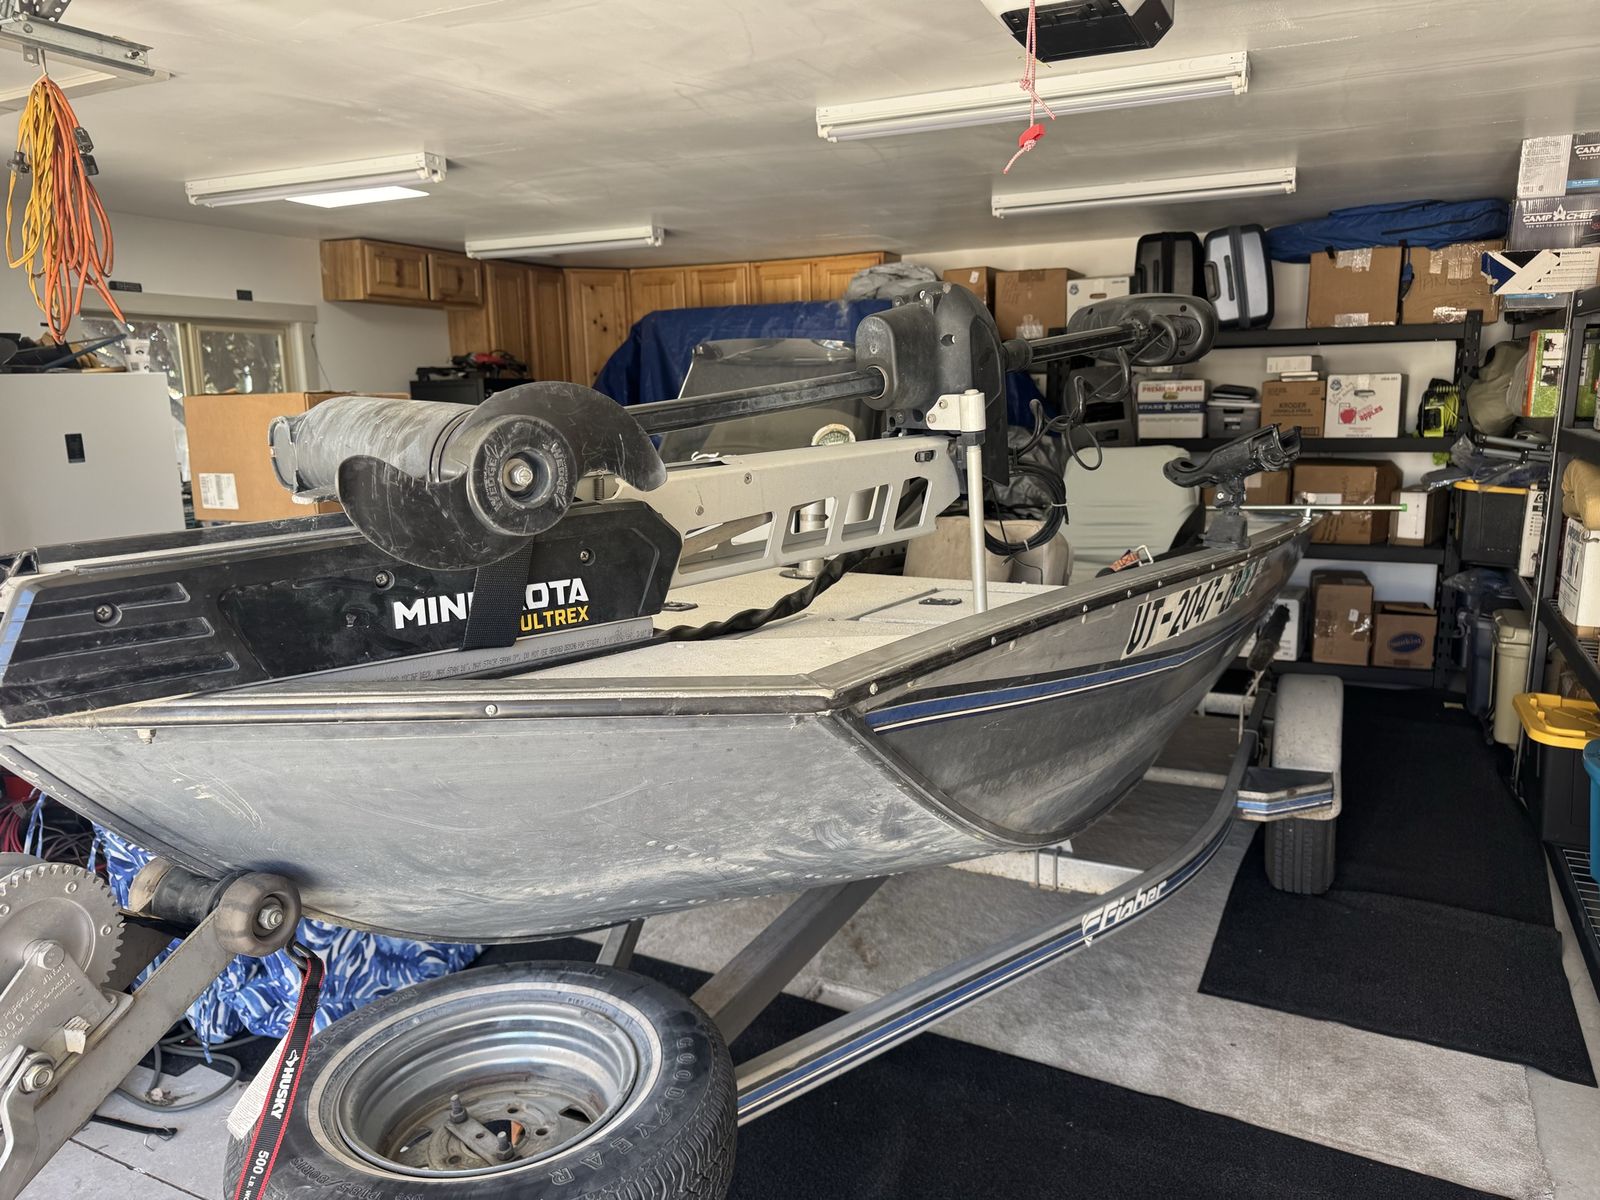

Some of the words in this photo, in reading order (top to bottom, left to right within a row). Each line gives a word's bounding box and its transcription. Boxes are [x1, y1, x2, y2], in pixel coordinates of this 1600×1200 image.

[1576, 146, 1600, 154] CAM
[1567, 212, 1596, 220] CHEF
[393, 591, 474, 630] MIN
[522, 577, 589, 611] OTA
[520, 605, 590, 632] ULTREX
[270, 1067, 295, 1120] HUSKY
[252, 1150, 270, 1176] 500
